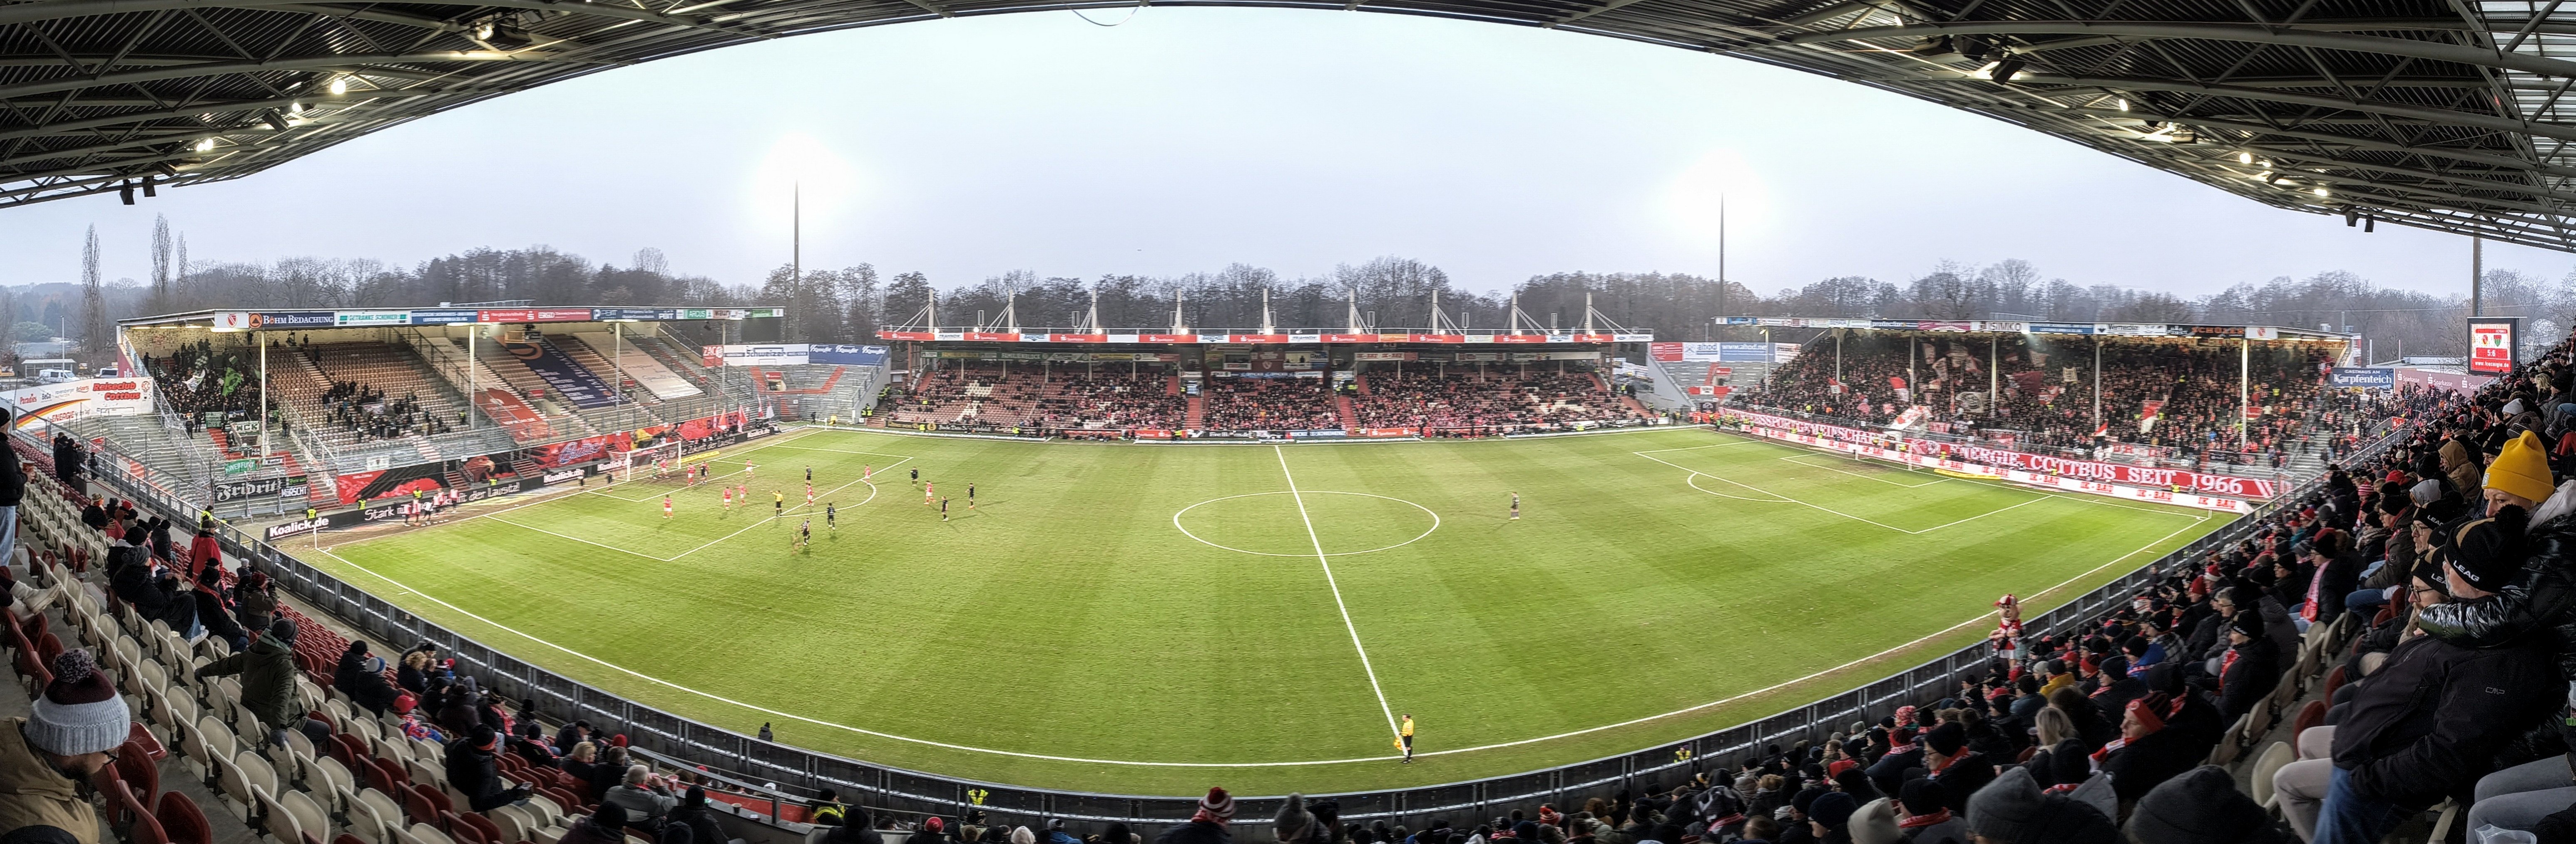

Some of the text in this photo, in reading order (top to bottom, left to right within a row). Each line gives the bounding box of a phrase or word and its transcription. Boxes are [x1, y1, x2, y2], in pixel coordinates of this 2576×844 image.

[288, 315, 333, 324] BEDACHUNG
[2333, 374, 2392, 384] Karpfenteich
[93, 382, 137, 392] Reiseclub
[104, 392, 141, 401] Cottbus
[707, 442, 718, 450] der
[2030, 455, 2116, 479] COTTBUS
[2128, 467, 2177, 486] SEIT
[2190, 474, 2243, 494] 1966
[365, 505, 395, 521] Stark
[469, 491, 486, 501] der
[487, 482, 520, 497] Lausitz!
[269, 517, 329, 537] Koalick.de
[2453, 560, 2480, 582] LEAG
[2431, 573, 2447, 586] LEA
